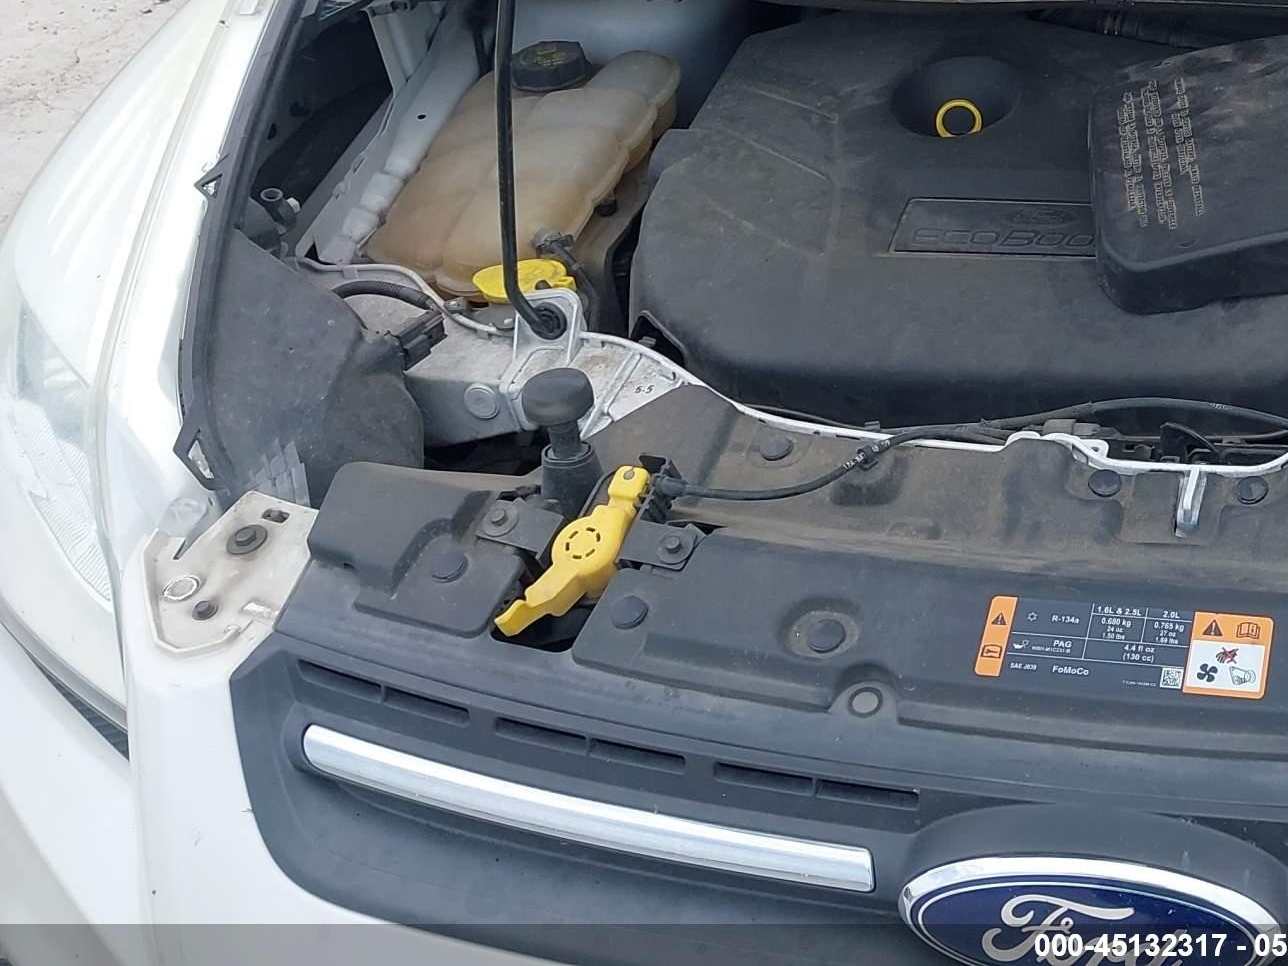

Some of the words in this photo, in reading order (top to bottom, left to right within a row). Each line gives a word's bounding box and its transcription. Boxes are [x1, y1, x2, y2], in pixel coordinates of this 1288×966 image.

[1097, 606, 1114, 614] 1.6L
[1124, 608, 1142, 616] 2.5L
[1052, 614, 1080, 624] R-134a
[1122, 619, 1131, 628] kg
[1175, 624, 1184, 632] kg
[1054, 640, 1072, 648] PAG
[1124, 644, 1135, 652] 4.4
[1142, 655, 1154, 663] cc)
[1052, 666, 1089, 676] FoMoCo
